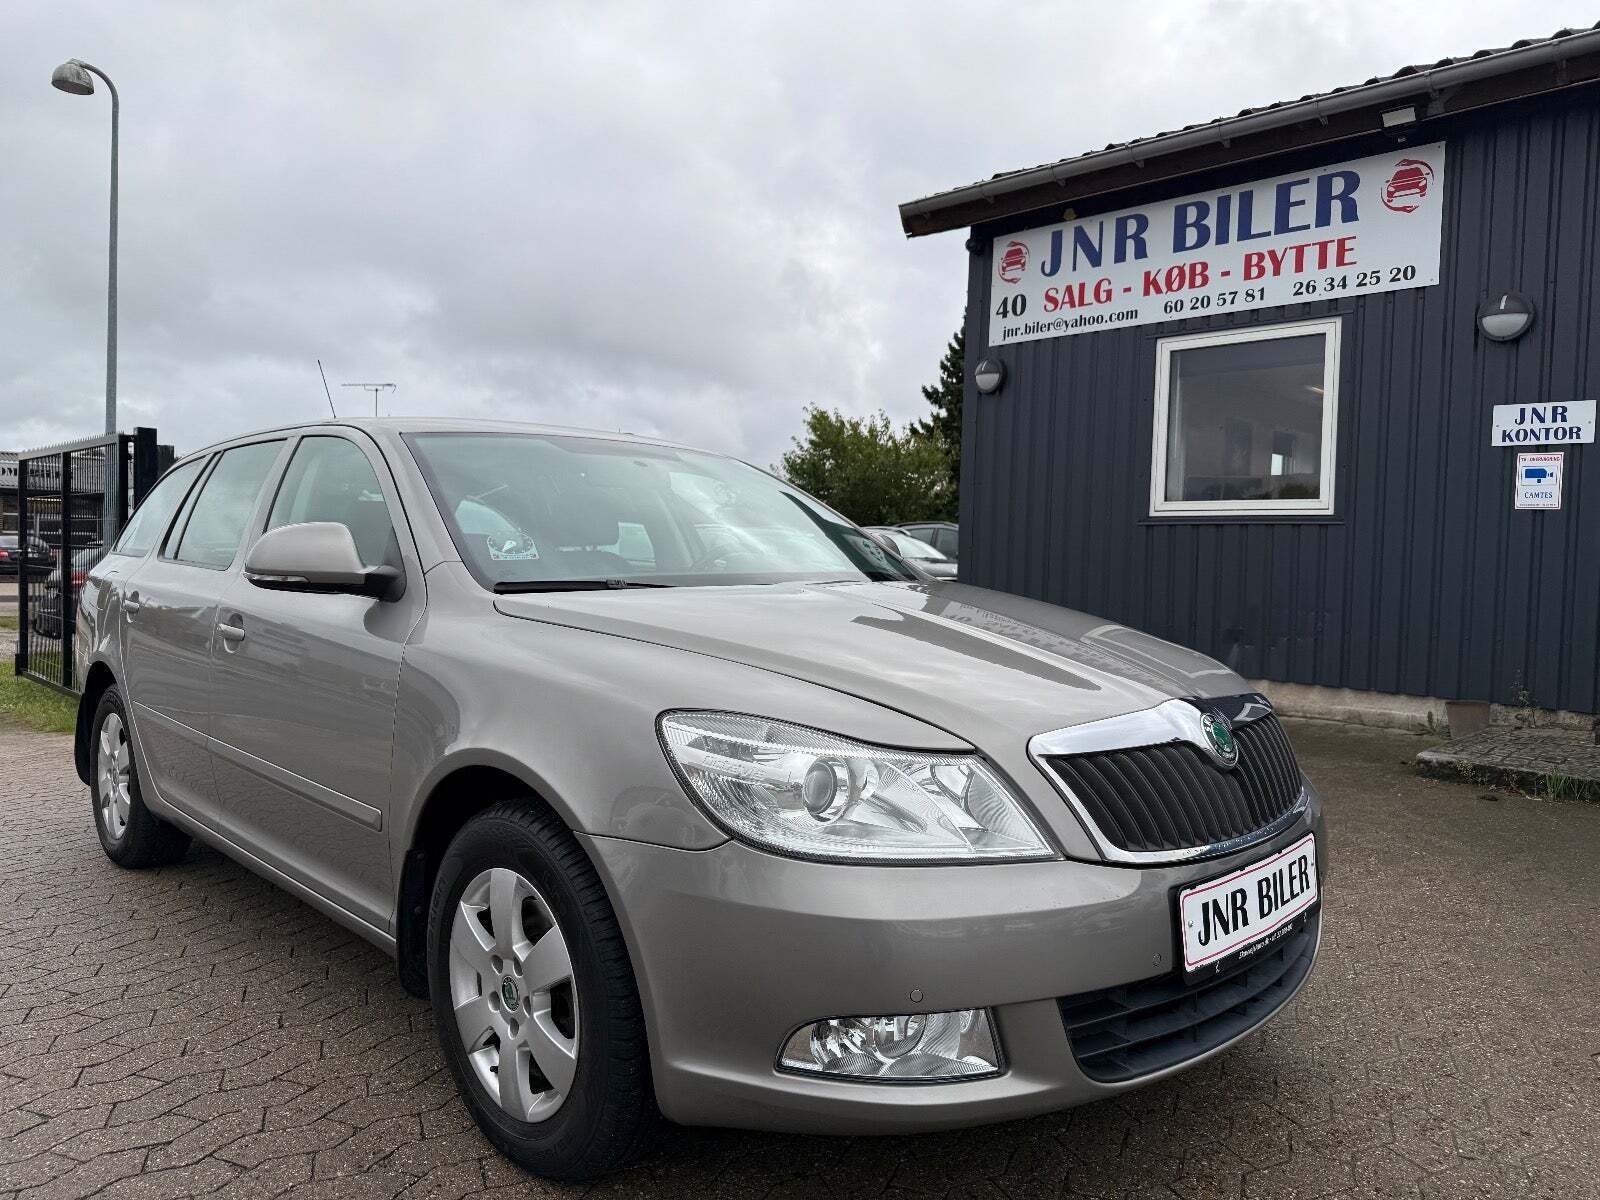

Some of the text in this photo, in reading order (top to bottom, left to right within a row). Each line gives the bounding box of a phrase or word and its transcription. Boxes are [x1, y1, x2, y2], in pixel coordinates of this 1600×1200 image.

[1041, 170, 1361, 278] JNR BILER
[1043, 278, 1112, 313] SALG
[1143, 261, 1209, 296] KØB
[1243, 235, 1358, 282] BYTTE
[1163, 264, 1417, 315] 60 20 57 81 26 34 25 20
[996, 293, 1027, 319] 40
[1002, 308, 1139, 341] jnr.biler@yahoo.com
[1501, 426, 1582, 443] KONTOR
[1514, 405, 1568, 425] JNR
[1198, 887, 1250, 946] JNR
[1257, 854, 1310, 920] BILER
